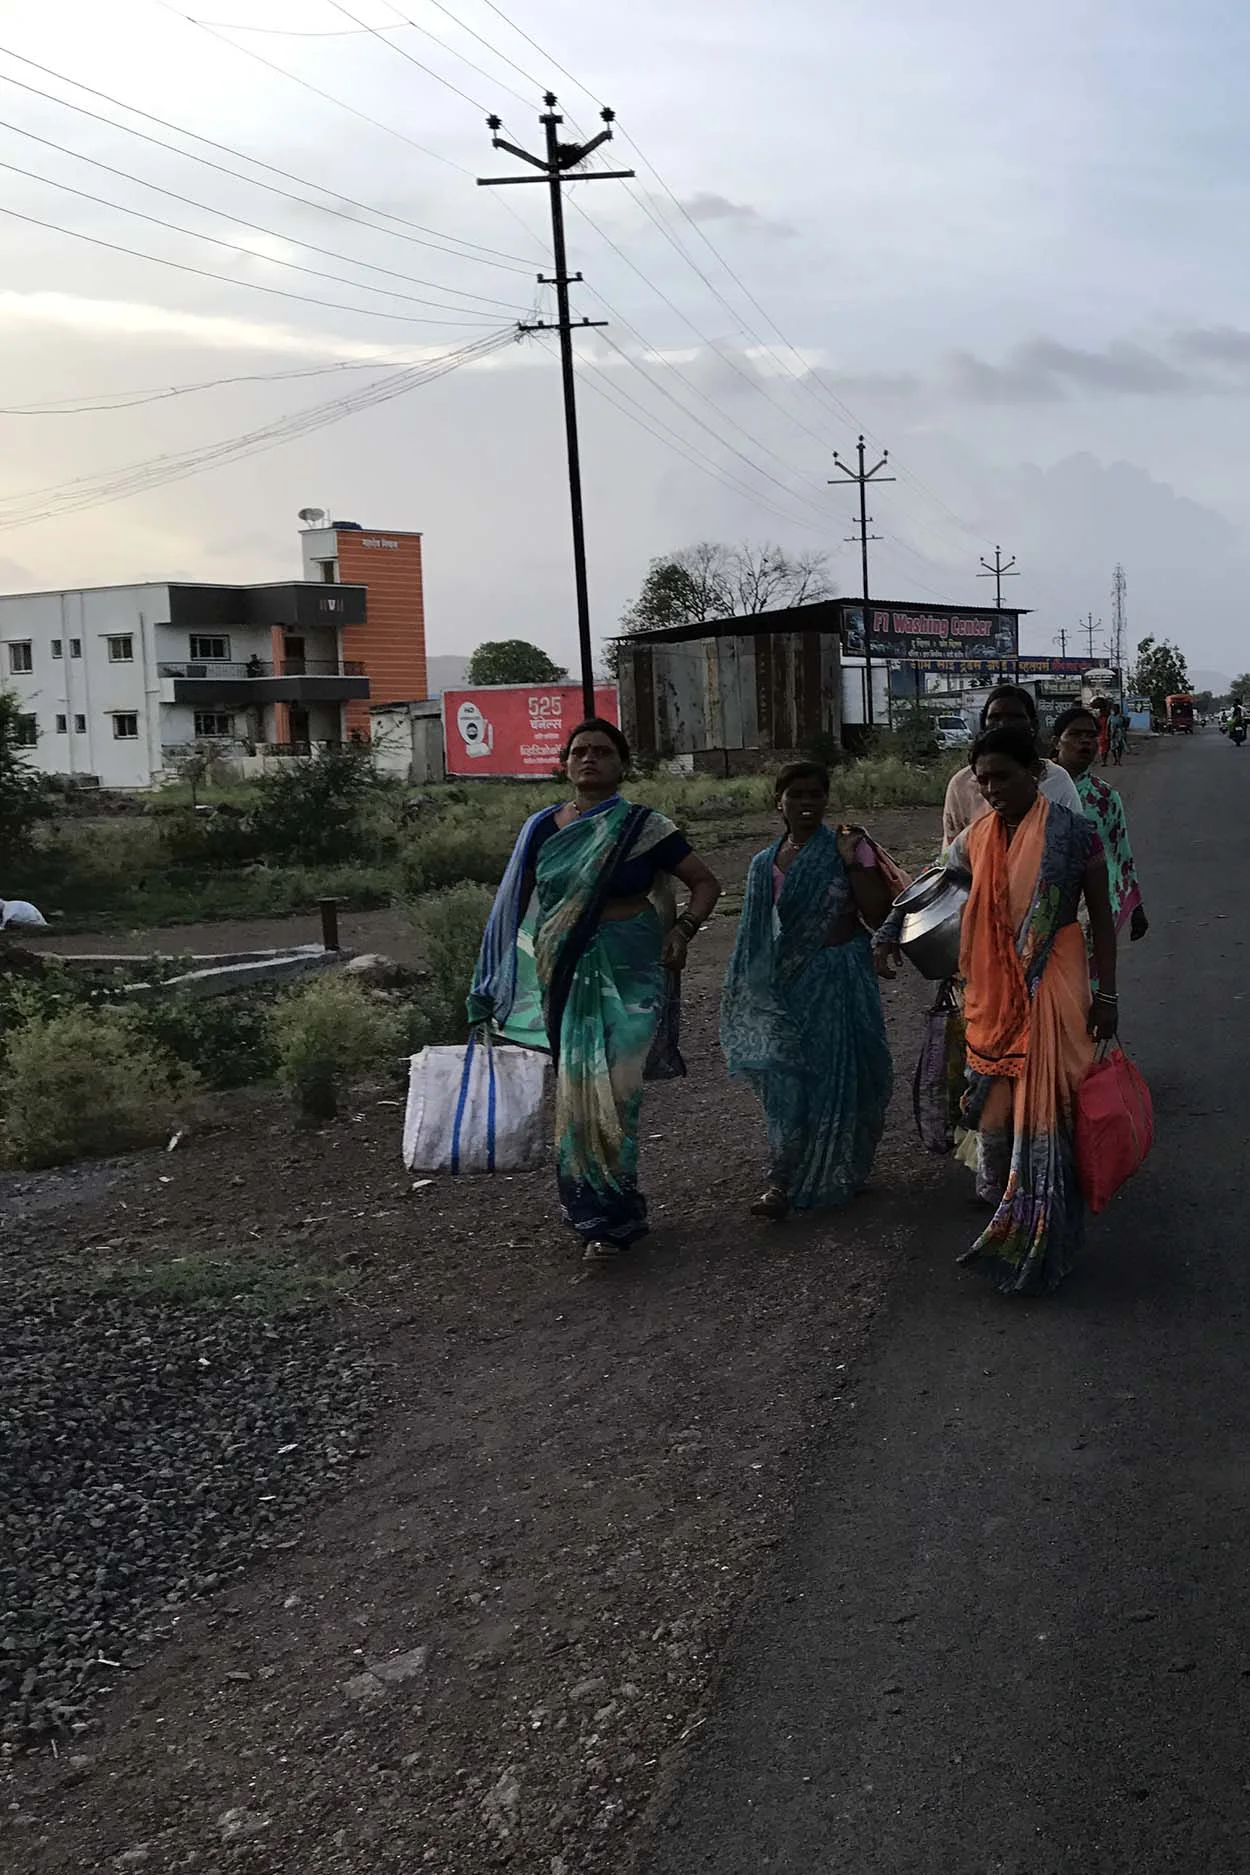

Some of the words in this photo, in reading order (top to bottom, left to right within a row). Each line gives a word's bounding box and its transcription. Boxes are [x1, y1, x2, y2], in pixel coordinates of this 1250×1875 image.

[893, 613, 949, 638] Washing
[951, 616, 993, 637] Center
[528, 696, 562, 716] 525
